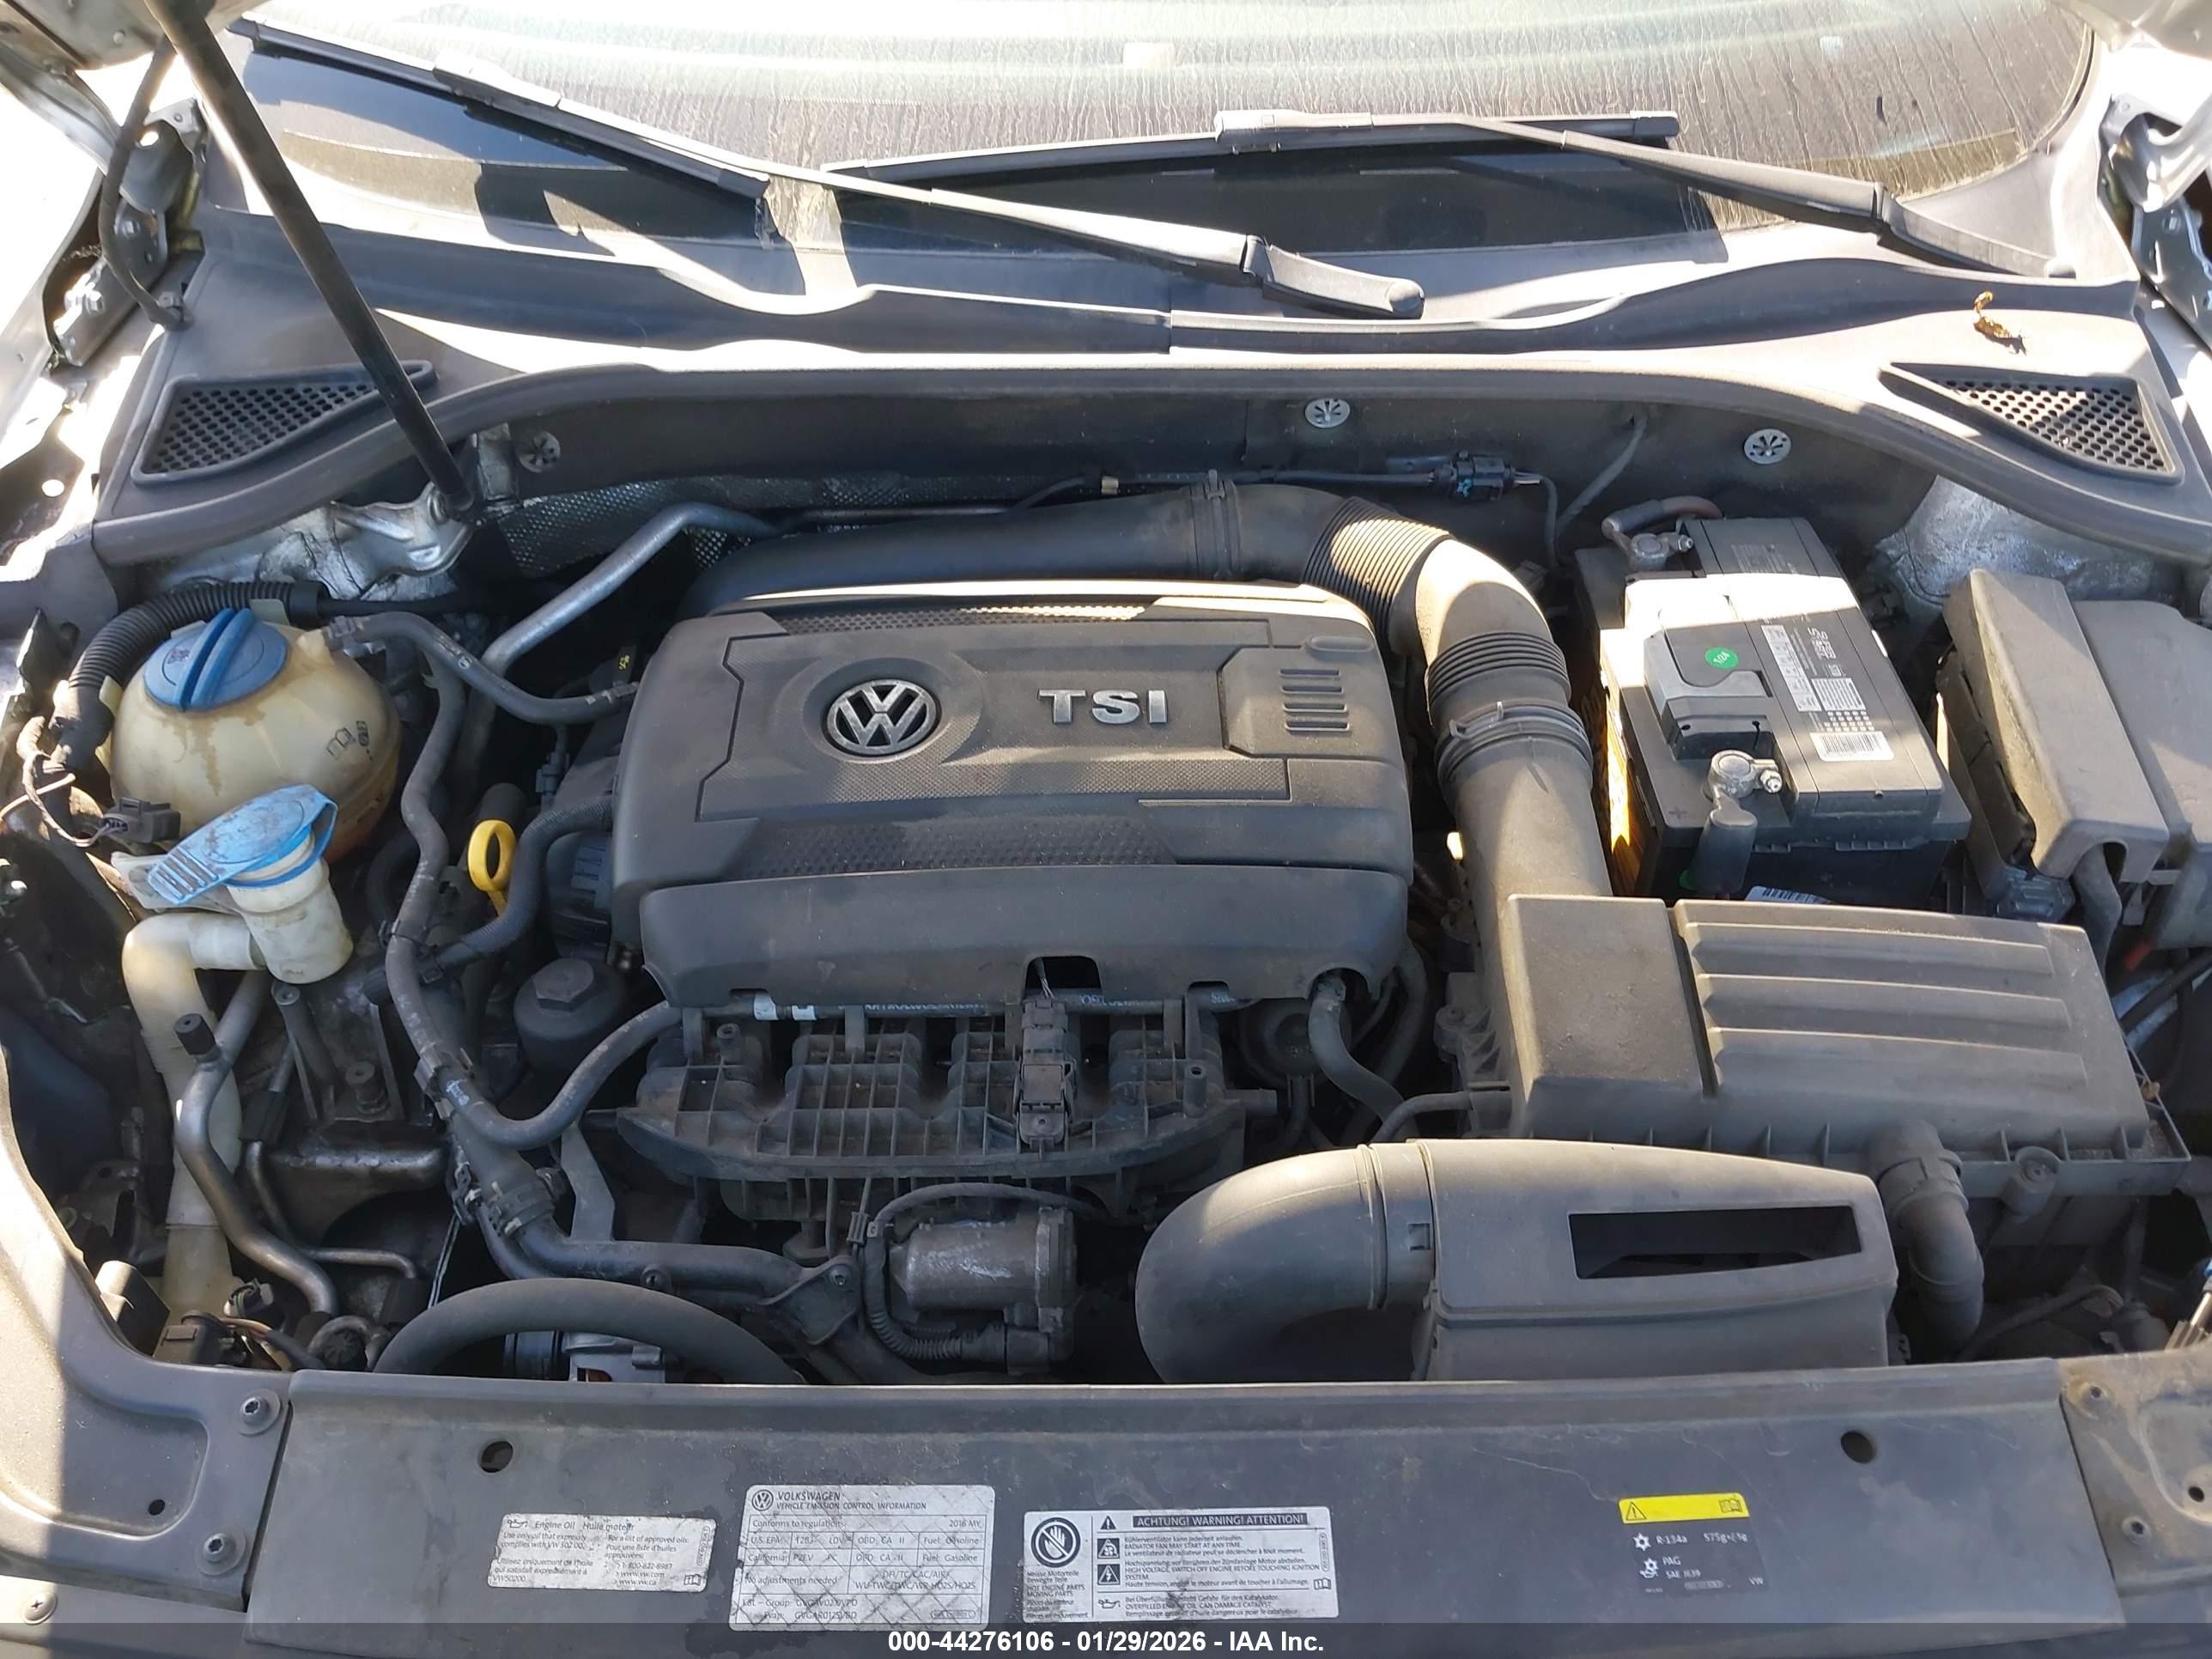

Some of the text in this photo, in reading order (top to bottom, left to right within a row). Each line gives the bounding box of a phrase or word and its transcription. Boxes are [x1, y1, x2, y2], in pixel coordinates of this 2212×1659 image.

[1038, 689, 1168, 725] TSI
[777, 1491, 841, 1502] VOLKSWAGEN
[752, 1519, 790, 1528] Conforms
[949, 1519, 967, 1528] 2016
[1137, 1514, 1304, 1527] ACHTUNG! WARNING! ATTENTION!
[535, 1521, 562, 1531] Engine
[645, 1536, 674, 1545] approved
[945, 1553, 978, 1562] Gasoline
[757, 1576, 807, 1586] adjustments
